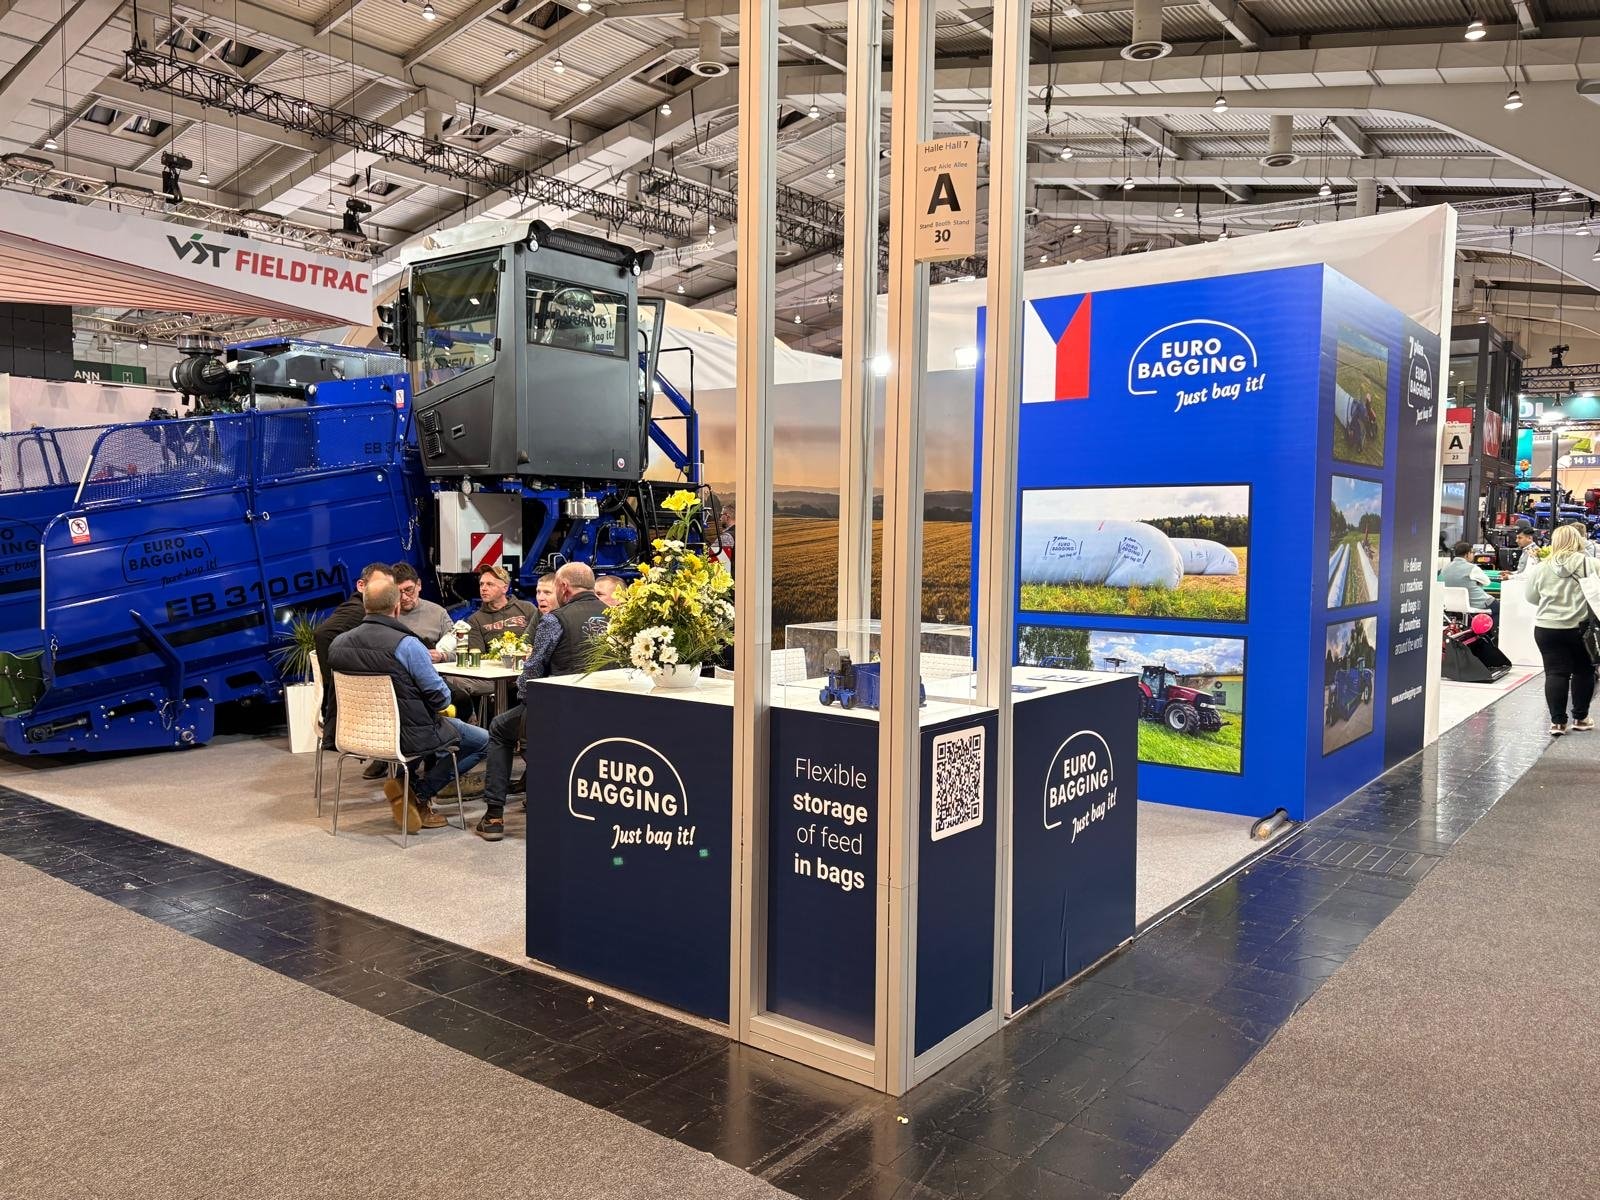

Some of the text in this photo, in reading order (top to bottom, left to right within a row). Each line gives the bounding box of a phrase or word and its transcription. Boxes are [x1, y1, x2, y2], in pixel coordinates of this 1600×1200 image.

[924, 140, 969, 154] Halle Hall 7
[927, 173, 961, 214] A
[919, 222, 934, 230] Stand
[934, 229, 951, 243] 30
[235, 250, 369, 293] FIELDTRAC
[1161, 337, 1222, 359] EURO
[1137, 354, 1247, 379] BAGGING
[1415, 365, 1427, 383] EURO
[1174, 373, 1266, 413] Just bag it!
[1410, 379, 1431, 400] BAGGING
[1448, 435, 1464, 450] A
[143, 537, 186, 554] EURO
[128, 547, 204, 571] BAGGING
[1409, 558, 1422, 572] deliver
[166, 565, 344, 624] EB 310 GM
[1406, 578, 1423, 591] machines
[1400, 600, 1408, 613] and
[1404, 617, 1421, 630] countries
[598, 759, 654, 787] EURO
[795, 758, 868, 789] Flexible
[1064, 751, 1096, 778] EURO
[577, 778, 678, 817] BAGGING
[1050, 769, 1108, 808] BAGGING
[792, 792, 869, 825] storage
[1071, 788, 1118, 843] Just bag it!
[611, 824, 697, 851] Just bag it!
[796, 823, 864, 856] of feed
[794, 853, 866, 892] in bags
